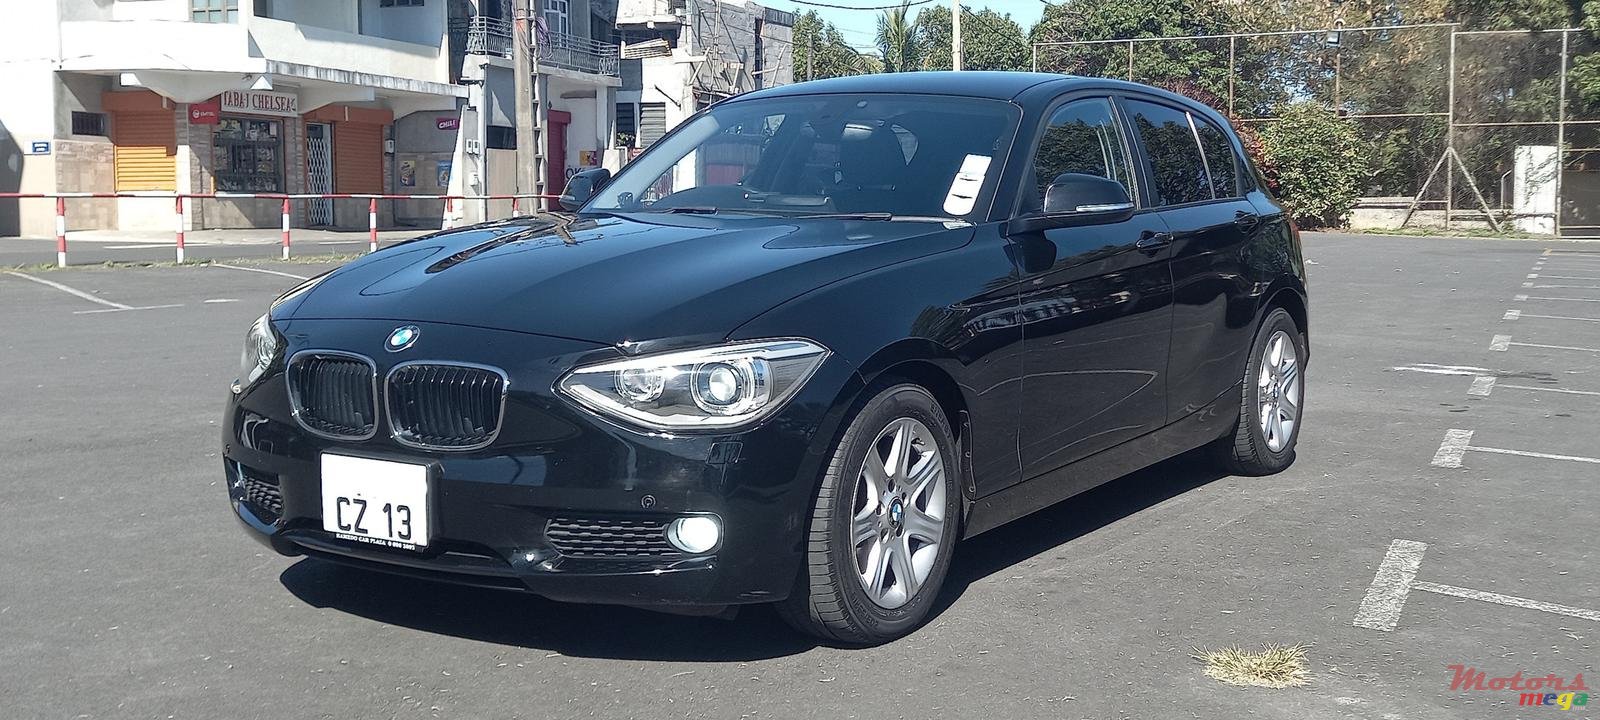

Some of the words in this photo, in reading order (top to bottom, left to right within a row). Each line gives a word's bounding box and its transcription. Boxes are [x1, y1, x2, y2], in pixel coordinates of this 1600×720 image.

[252, 93, 292, 112] CHELSEA
[336, 496, 368, 534] CZ
[382, 502, 411, 540] 13
